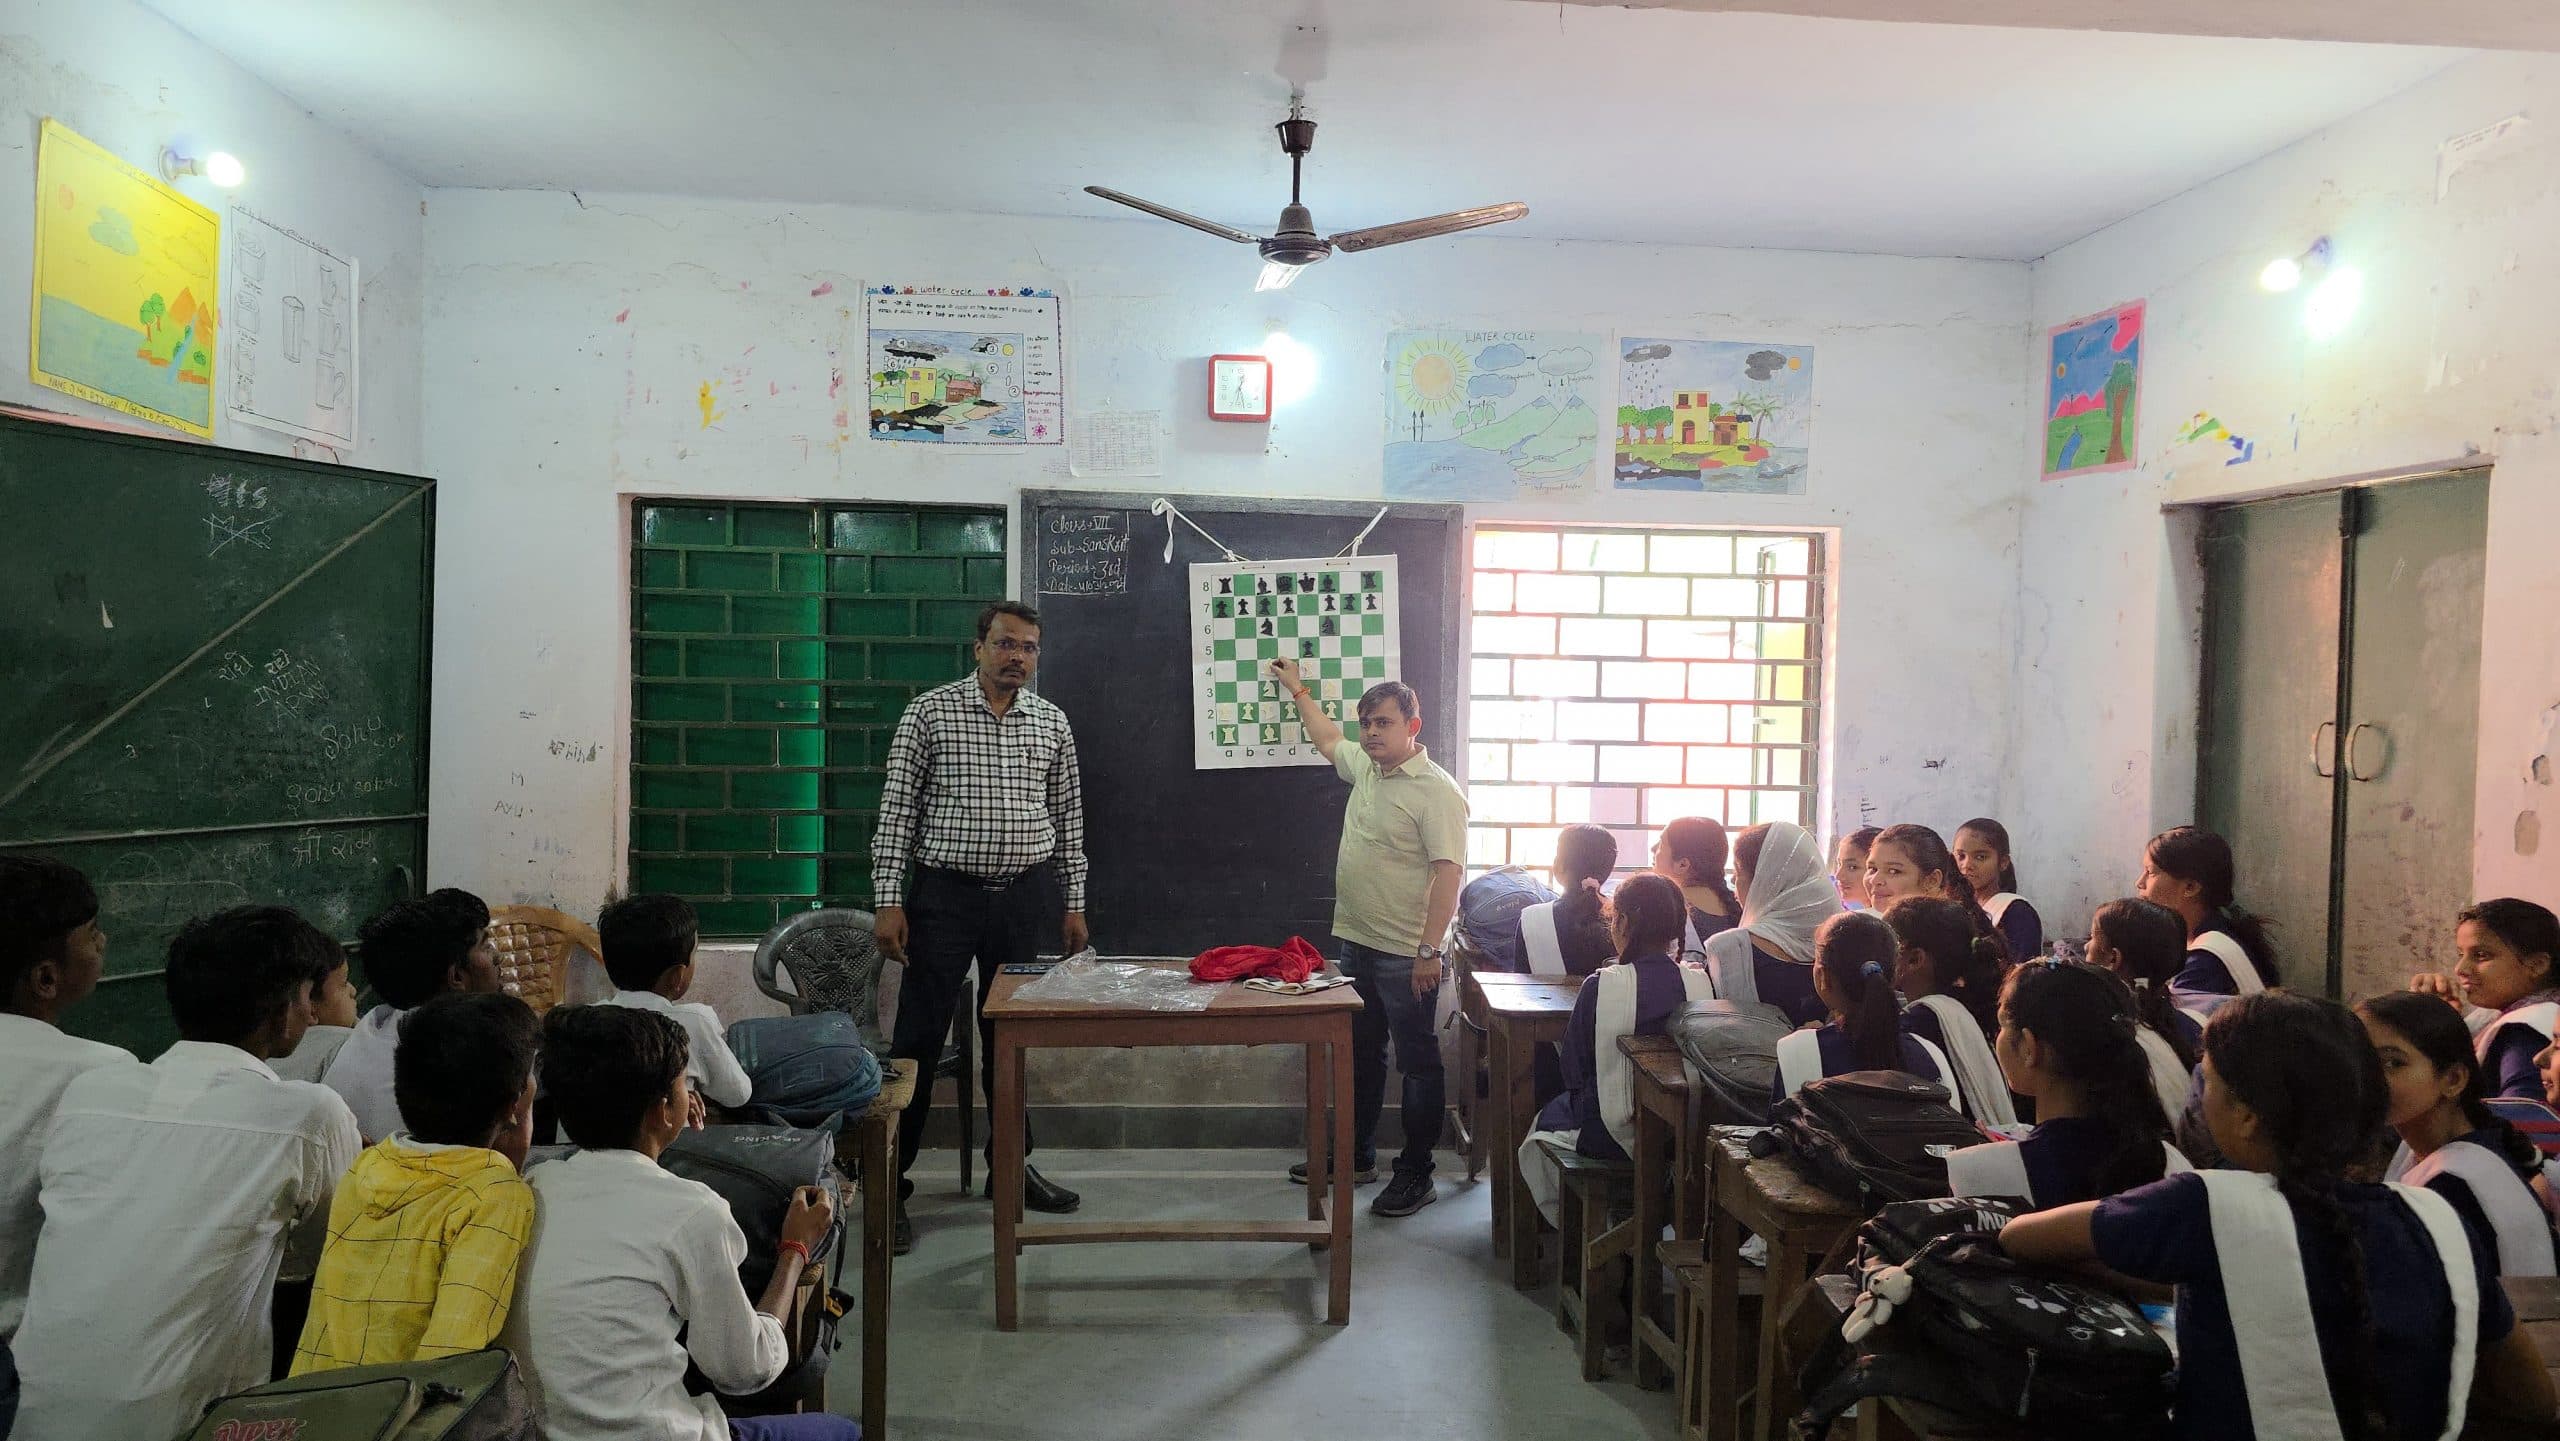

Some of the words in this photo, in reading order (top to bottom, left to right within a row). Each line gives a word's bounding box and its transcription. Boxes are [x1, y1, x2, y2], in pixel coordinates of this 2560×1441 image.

[1203, 582, 1210, 591] 8
[1204, 603, 1210, 613] 7
[1204, 624, 1211, 634] 6
[1205, 646, 1212, 655] 5
[1206, 667, 1212, 676] 4
[1207, 688, 1213, 697] 3
[1208, 709, 1214, 719] 2
[1209, 731, 1214, 740] 1
[1246, 747, 1254, 757] b
[1267, 748, 1275, 756] c
[1288, 745, 1296, 756] d
